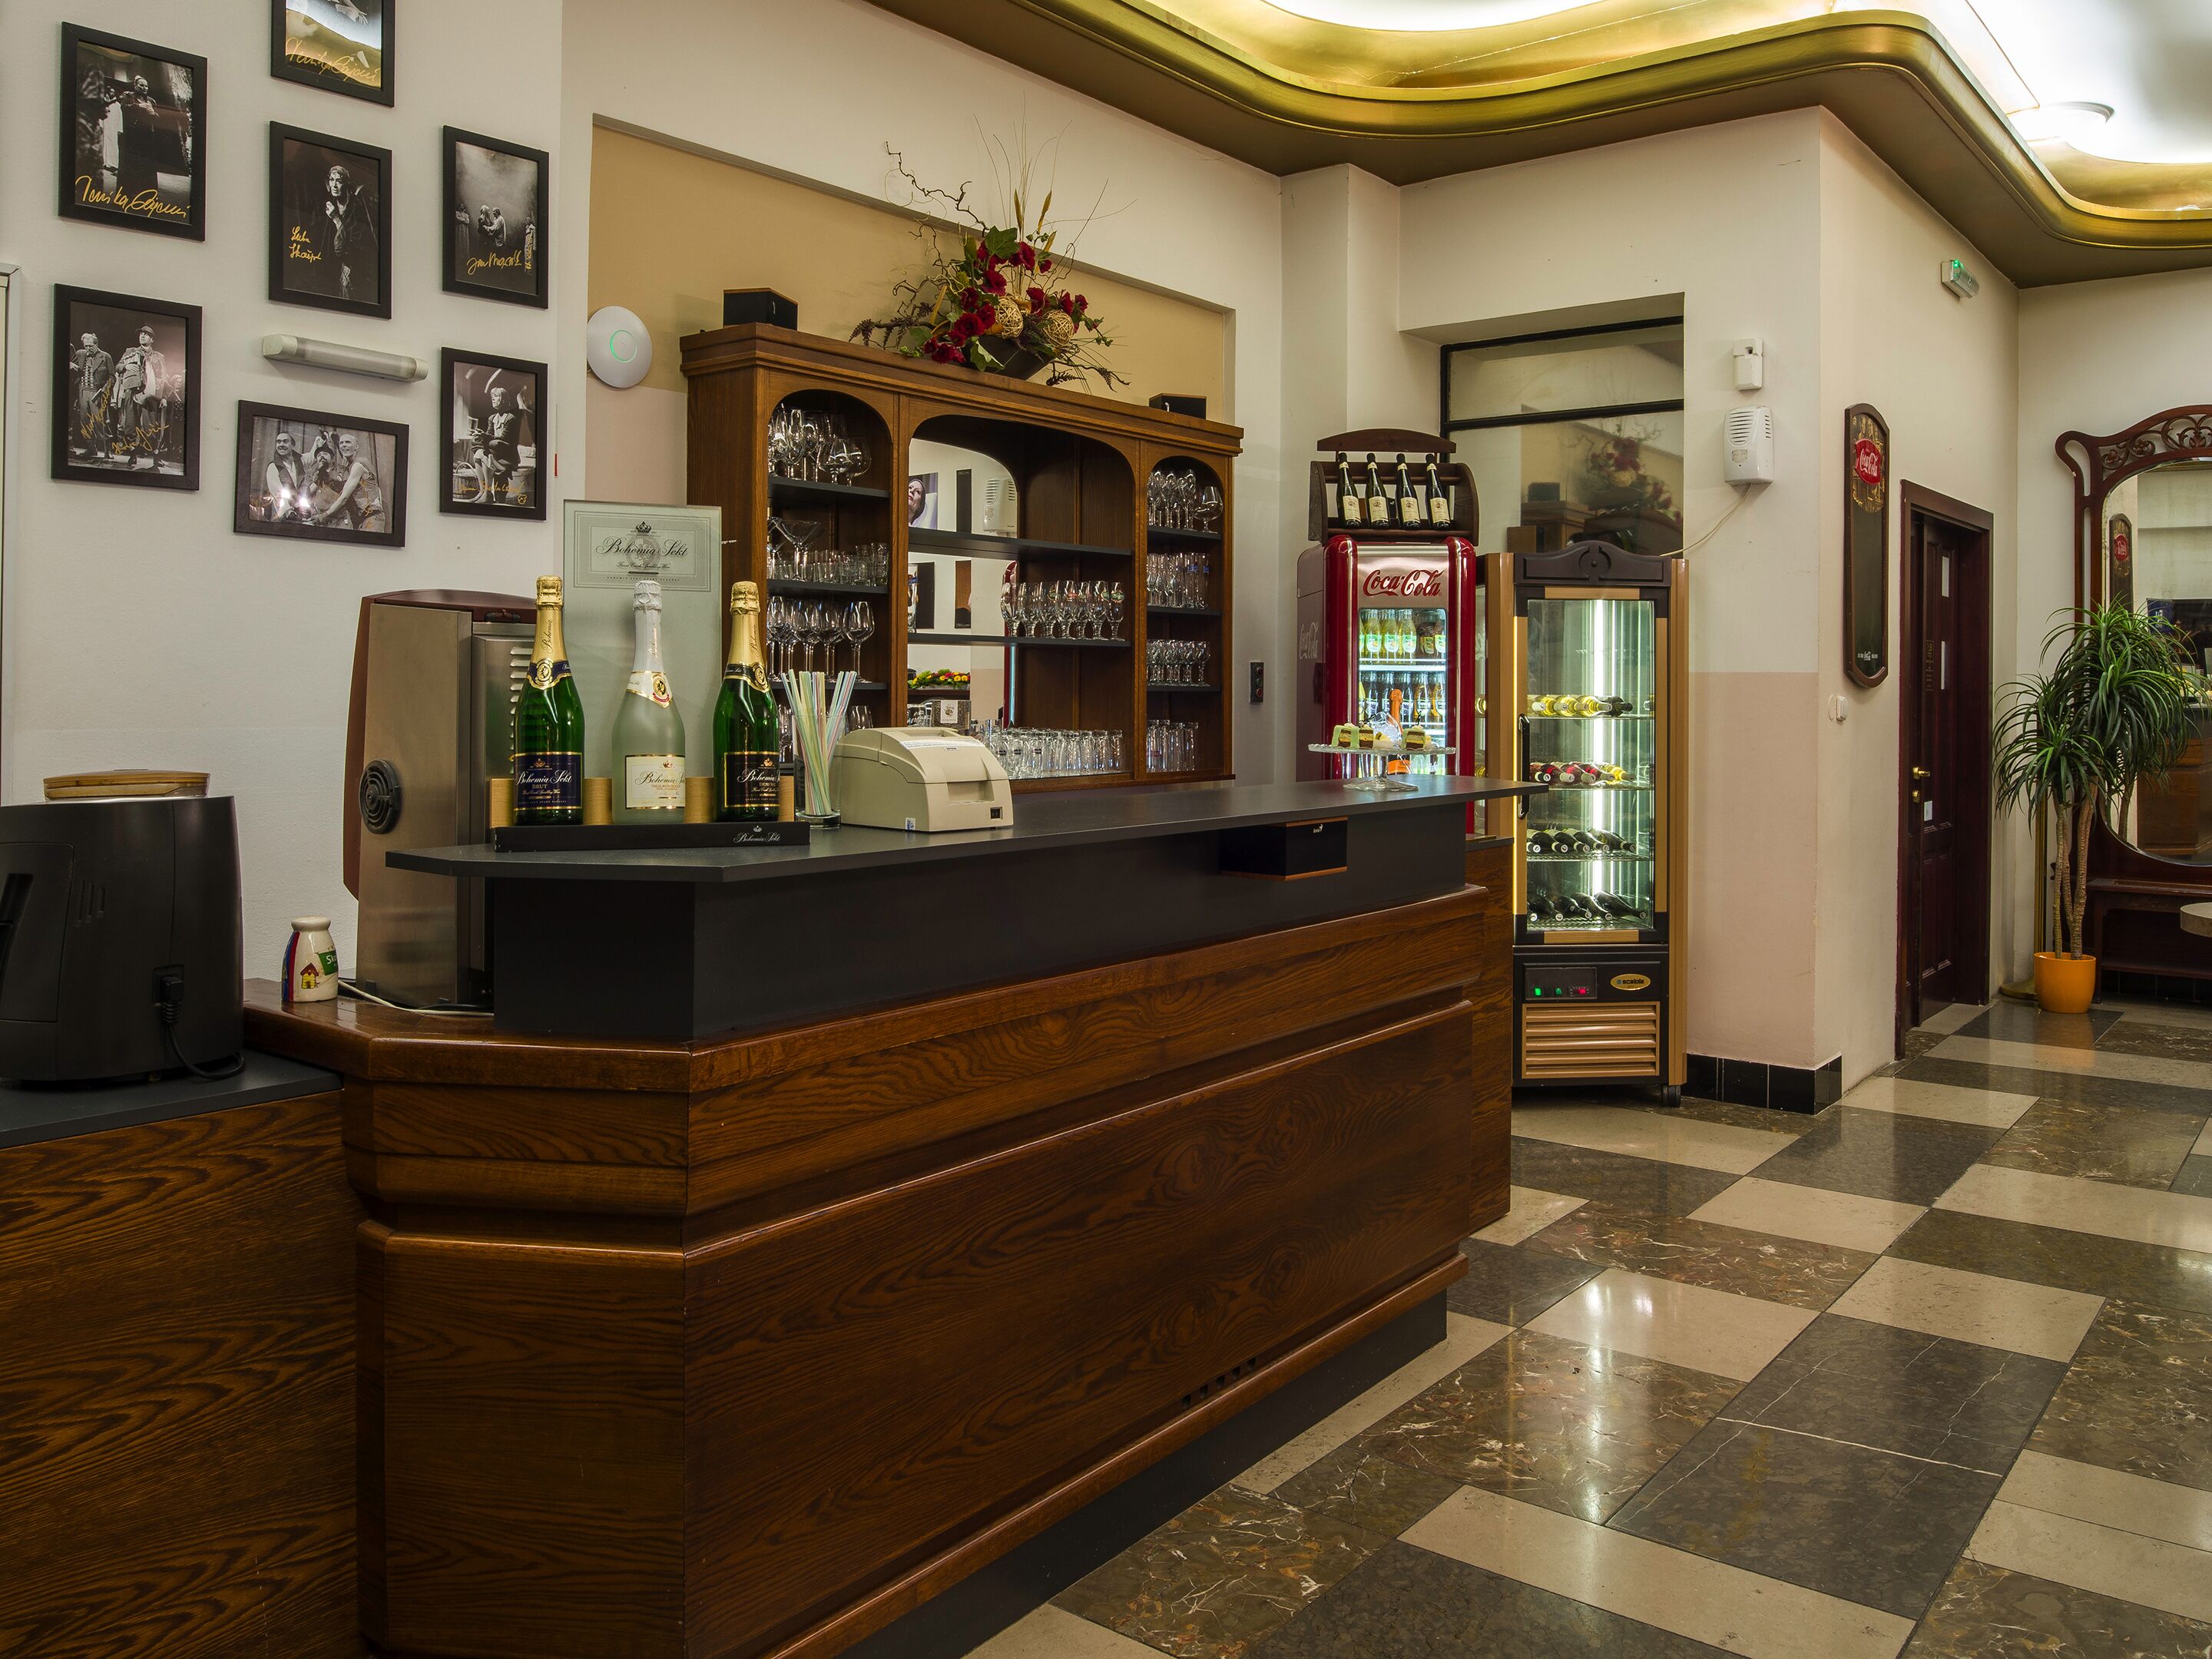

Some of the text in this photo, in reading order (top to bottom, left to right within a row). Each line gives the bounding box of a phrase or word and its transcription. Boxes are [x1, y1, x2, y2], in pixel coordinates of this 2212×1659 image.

[595, 535, 689, 558] Bohemia Sekt
[1363, 569, 1445, 597] Coca-Cola
[541, 618, 554, 654] Bohemia
[515, 769, 573, 786] Bohemia Sekt
[634, 770, 675, 785] Bohemia
[737, 769, 775, 783] Bohemia
[733, 831, 781, 843] Bohemia Sekt
